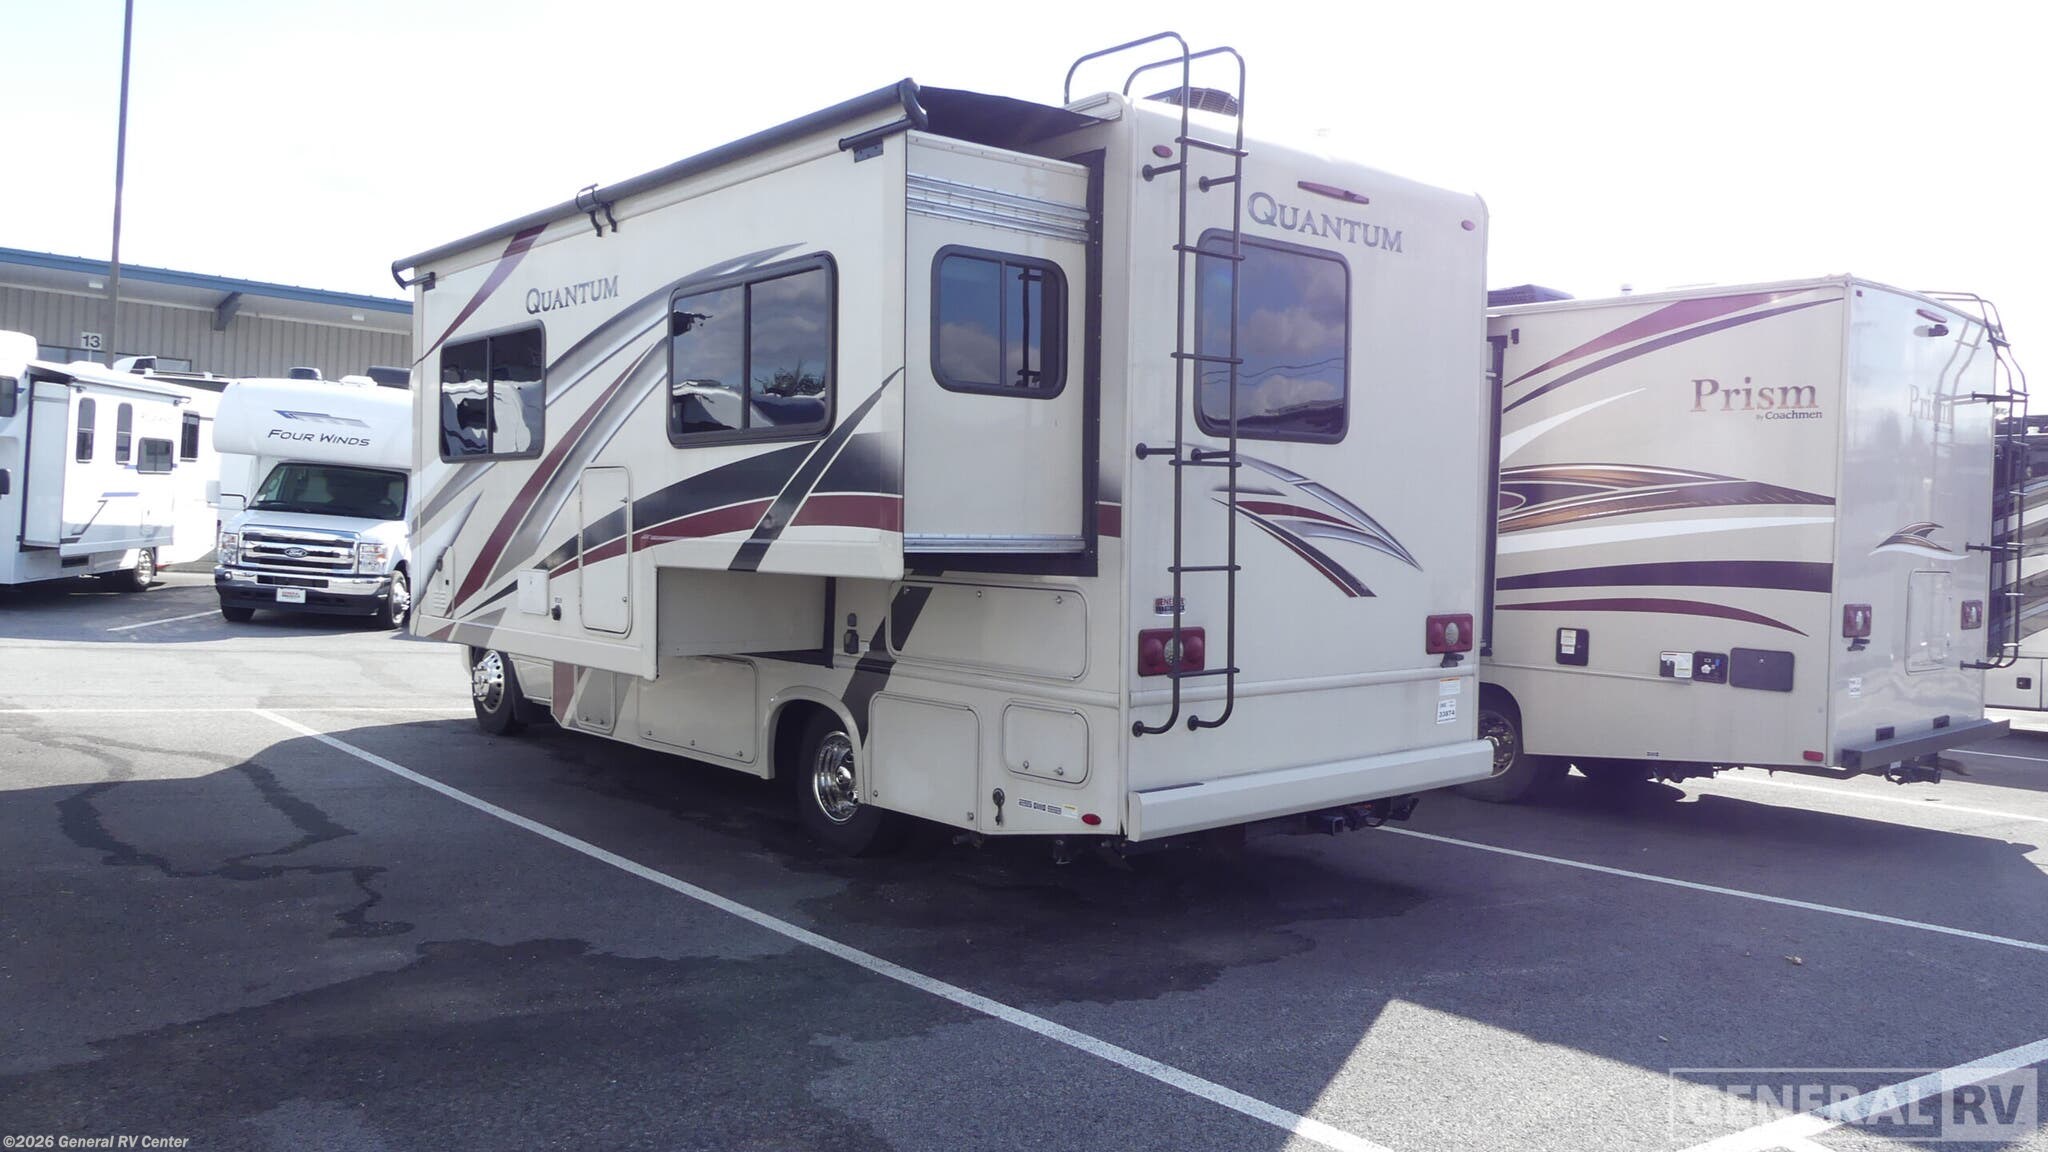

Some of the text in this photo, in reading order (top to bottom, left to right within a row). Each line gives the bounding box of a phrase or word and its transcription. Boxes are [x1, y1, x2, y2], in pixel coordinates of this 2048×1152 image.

[1248, 191, 1403, 253] QUANTUM
[526, 275, 619, 315] QUANTUM
[82, 335, 101, 348] 13
[1690, 376, 1819, 412] Prism
[1765, 410, 1823, 420] Coachmen
[267, 429, 371, 446] FOUR WINDS
